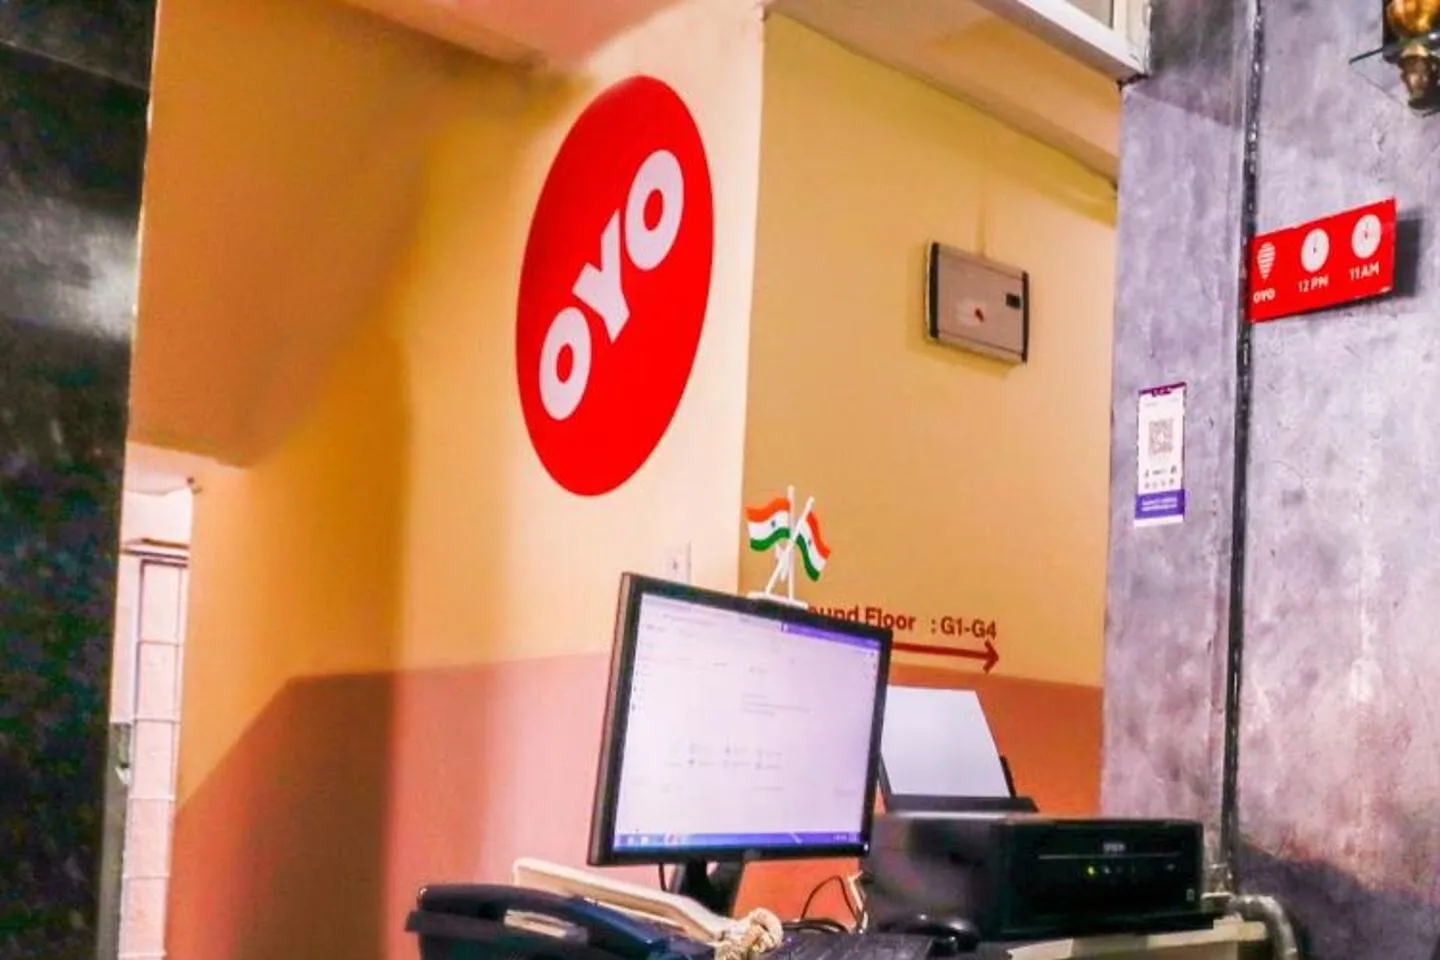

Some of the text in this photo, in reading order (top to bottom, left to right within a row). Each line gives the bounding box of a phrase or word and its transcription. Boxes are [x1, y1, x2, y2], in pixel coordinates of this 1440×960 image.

[539, 148, 684, 421] OYO
[808, 604, 859, 622] ound
[865, 606, 916, 630] Floor
